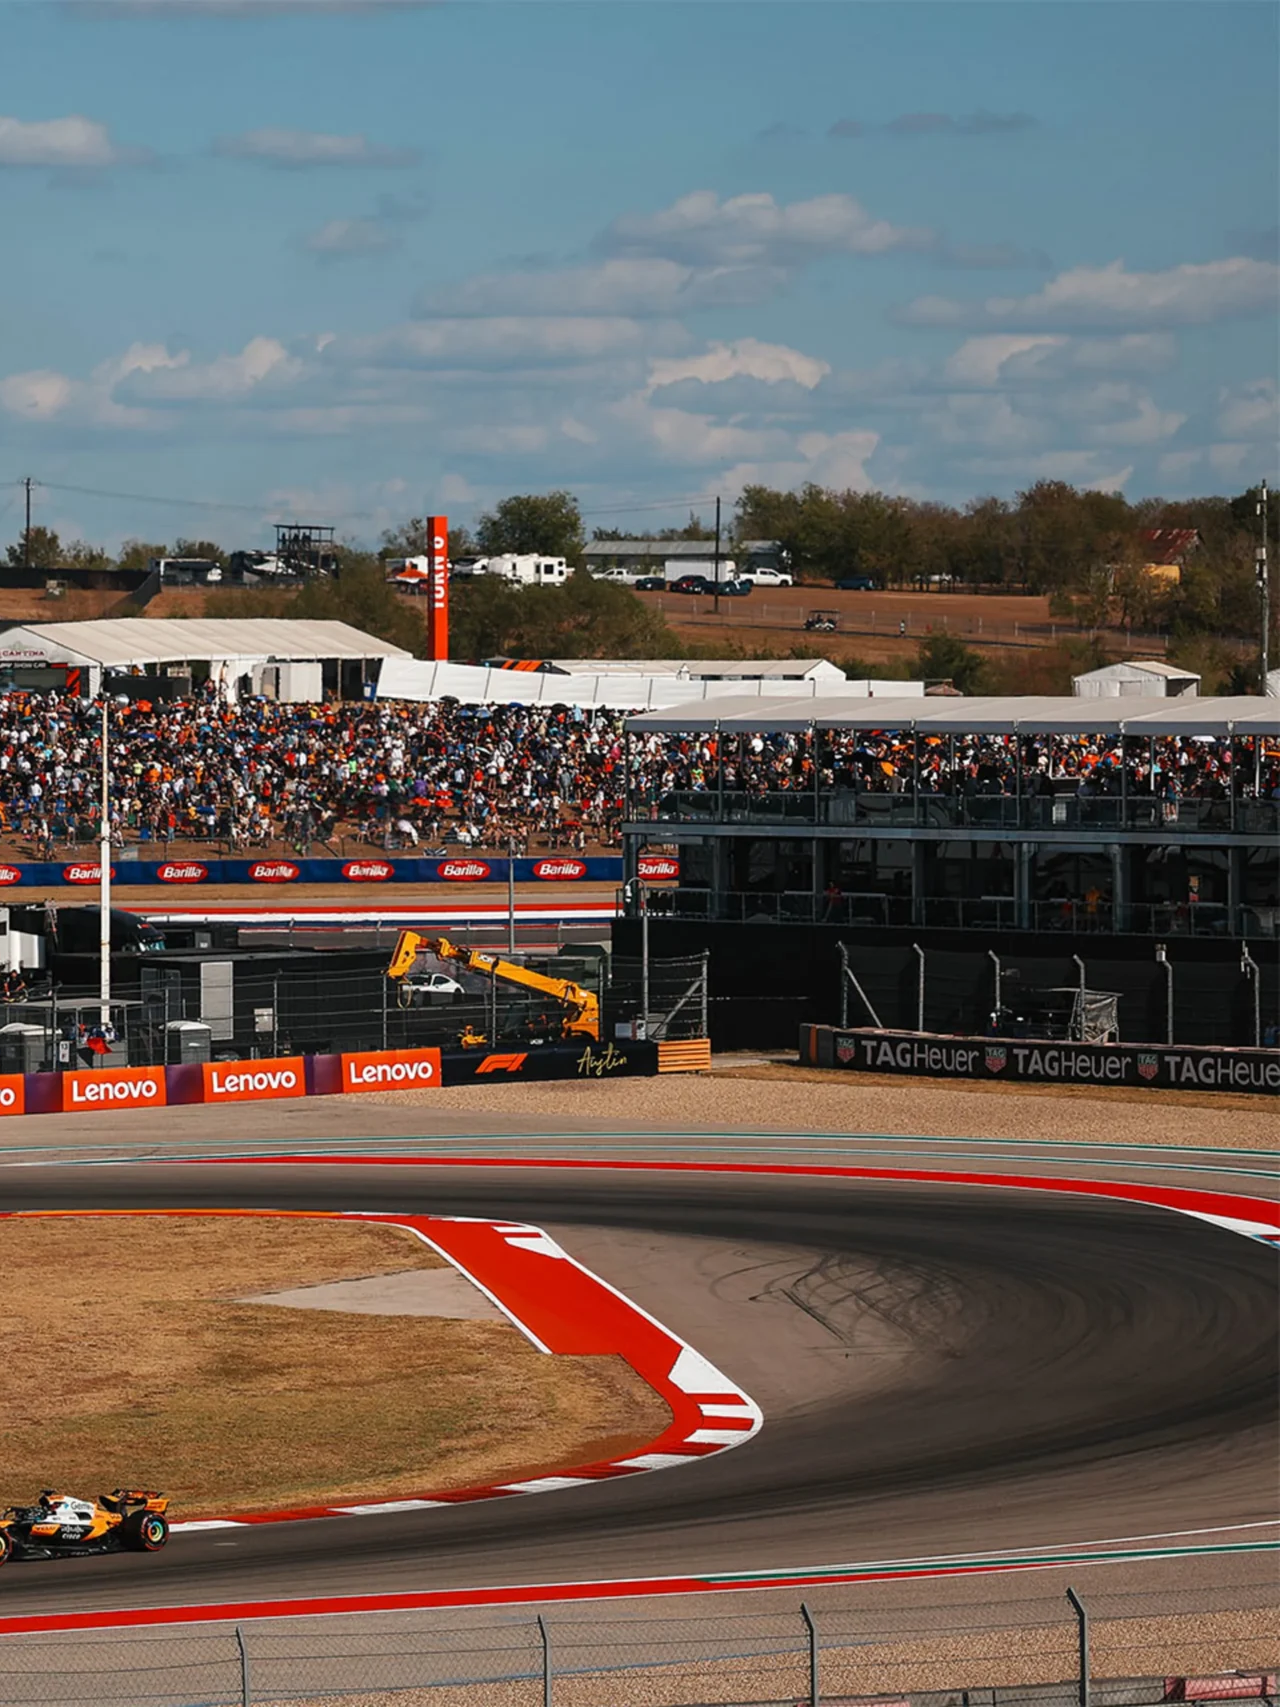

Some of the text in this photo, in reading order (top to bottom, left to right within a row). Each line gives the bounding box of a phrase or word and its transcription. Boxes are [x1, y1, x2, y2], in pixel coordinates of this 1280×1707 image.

[69, 867, 102, 880] Barill
[163, 866, 203, 878] Barilla
[254, 865, 294, 877] Barilla
[349, 865, 389, 877] Barilla
[443, 863, 486, 876] Barilla
[539, 863, 582, 875] Barilla
[577, 1042, 627, 1076] Austin
[350, 1062, 433, 1085] Lenovo
[1164, 1055, 1280, 1087] TAGHeue
[212, 1070, 296, 1093] Lenovo
[72, 1078, 157, 1102] Lenovo
